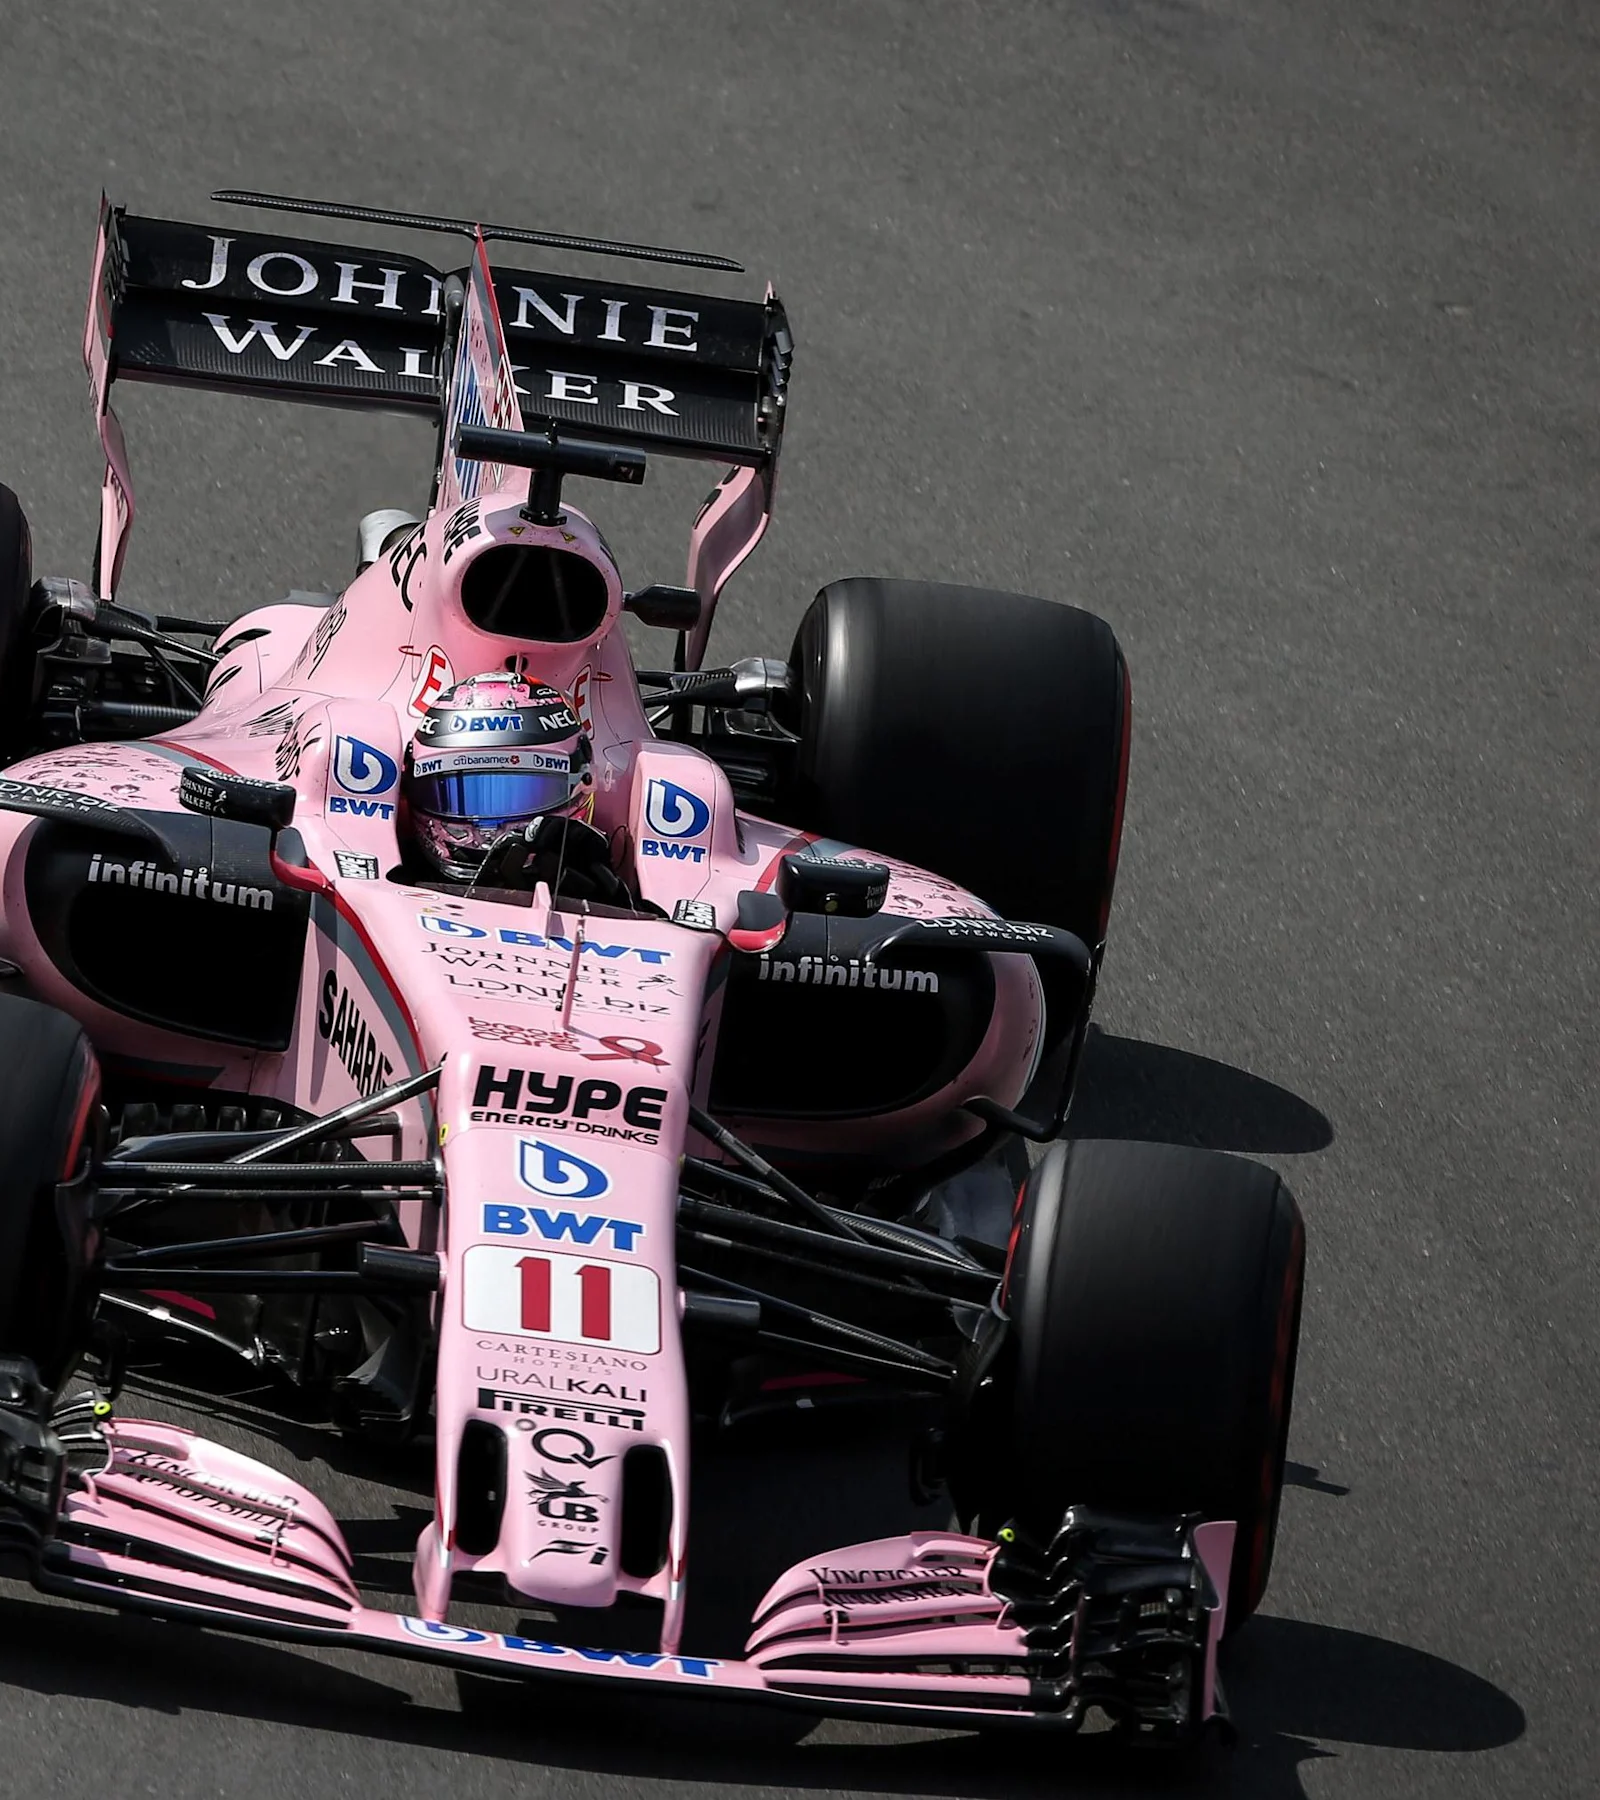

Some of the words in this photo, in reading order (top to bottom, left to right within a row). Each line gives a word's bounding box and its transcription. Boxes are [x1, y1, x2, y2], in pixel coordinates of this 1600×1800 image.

[469, 714, 523, 732] BWT
[538, 708, 577, 732] NEC
[422, 759, 442, 773] BWT
[545, 757, 569, 771] BWT
[330, 797, 394, 819] BWT
[642, 840, 706, 862] BWT
[88, 854, 273, 910] infinitum
[499, 929, 671, 965] BWT
[949, 929, 1038, 942] EYEWEAR
[422, 941, 619, 977] JOHNNIE
[439, 955, 623, 988] WALKER
[758, 954, 939, 993] infinitum
[472, 1031, 582, 1052] care
[472, 1065, 667, 1131] HYPE
[575, 1122, 659, 1145] DRINKS
[483, 1203, 643, 1251] BWT
[514, 1257, 610, 1341] 11
[476, 1340, 648, 1371] CARTESIANO
[513, 1356, 613, 1376] HOTELS
[477, 1365, 647, 1403] URALKALI
[478, 1387, 647, 1431] PIRELLI
[537, 1501, 600, 1523] UB
[537, 1519, 600, 1534] GROUP
[501, 1634, 721, 1679] BWT
